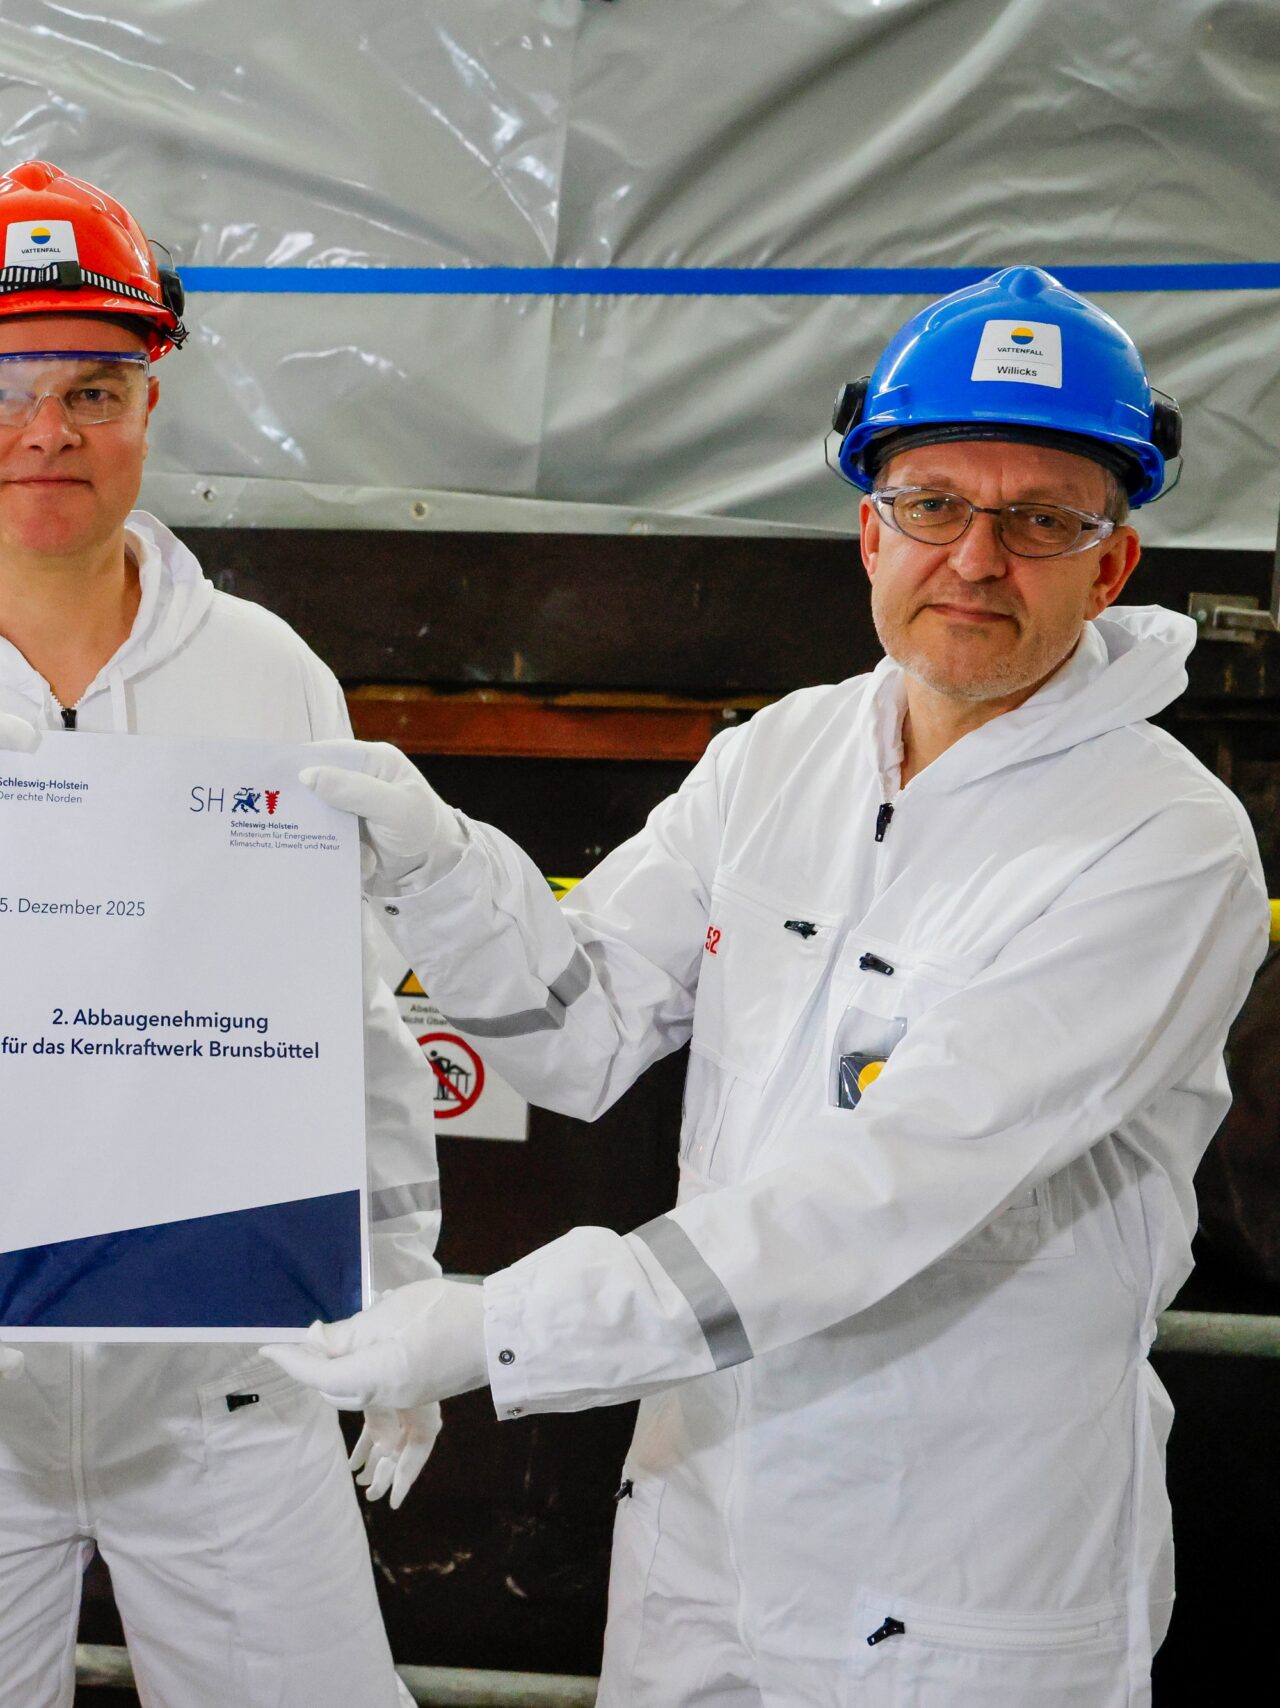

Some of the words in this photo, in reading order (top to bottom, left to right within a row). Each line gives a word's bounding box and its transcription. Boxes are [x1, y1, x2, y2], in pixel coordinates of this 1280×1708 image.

[997, 347, 1043, 356] VATTENFALL
[997, 366, 1037, 377] Willicks
[16, 792, 43, 802] echte
[46, 793, 82, 803] Norden
[189, 786, 224, 812] SH
[230, 820, 298, 830] Schleswig-Holstein
[230, 830, 270, 838] Ministerium
[272, 831, 282, 839] für
[284, 832, 337, 842] Energiewende,
[230, 840, 273, 849] Klimaschutz,
[275, 841, 302, 849] Umwelt
[304, 842, 318, 850] und
[18, 898, 102, 915] Dezember
[105, 900, 145, 917] 2025
[705, 926, 721, 954] 52
[52, 1008, 69, 1025] 2.
[73, 1008, 269, 1034] Abbaugenehmigung
[1, 1036, 27, 1054] für
[32, 1037, 65, 1055] das
[71, 1038, 203, 1057] Kernkraftwerk
[209, 1040, 320, 1059] Brunsbüttel
